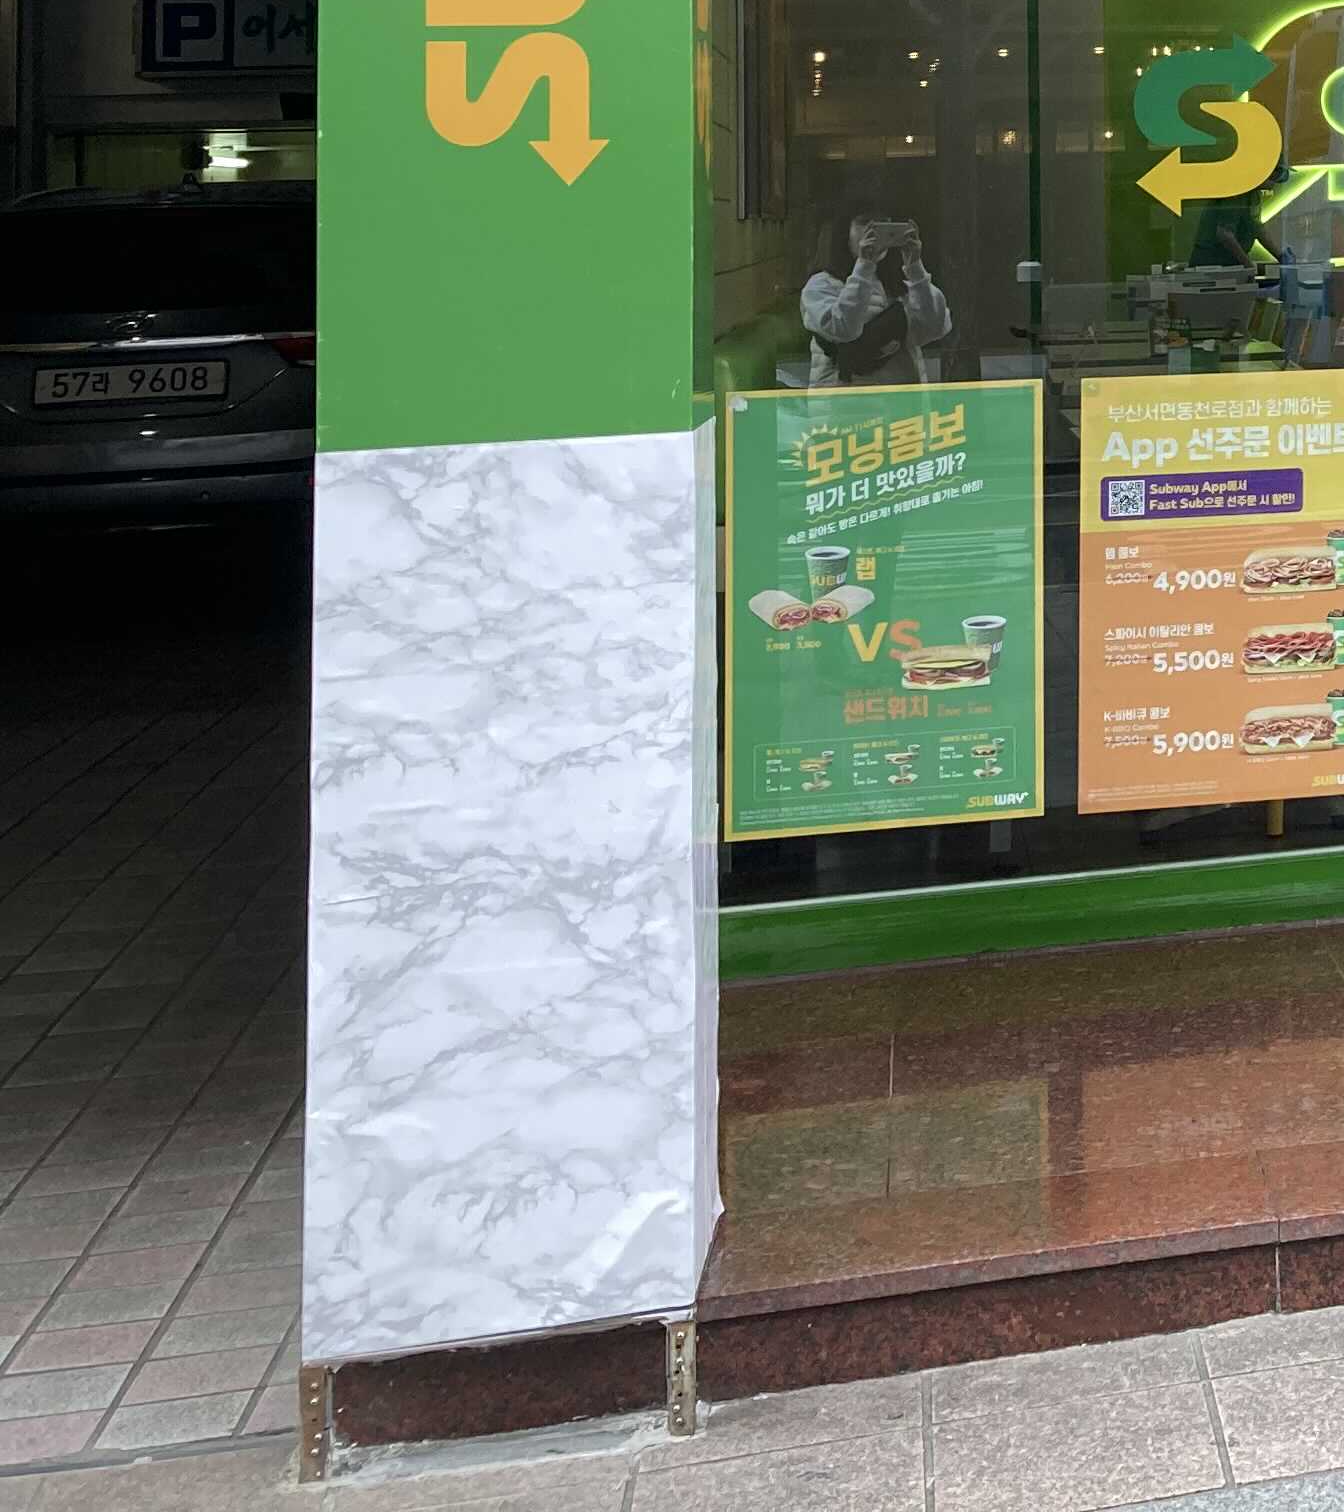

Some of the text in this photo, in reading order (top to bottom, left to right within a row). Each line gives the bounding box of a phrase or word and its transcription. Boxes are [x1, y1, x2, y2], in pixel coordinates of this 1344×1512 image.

[51, 366, 209, 399] 57라 9608
[1108, 396, 1333, 424] 부산서면동천로점과 함께하는
[806, 403, 967, 487] 모닝콤보
[1101, 431, 1178, 468] App
[1186, 425, 1271, 461] 선주문
[805, 452, 967, 515] 뭐가 더 맛있을까?
[1149, 482, 1199, 496] Subway
[1149, 499, 1177, 511] Fast
[855, 556, 876, 581] 랩
[1153, 569, 1236, 593] 4,900원
[847, 619, 923, 663] VS
[1152, 649, 1234, 675] 5,500원
[1152, 729, 1234, 756] 5,900원
[966, 791, 1029, 809] SUBWAY
